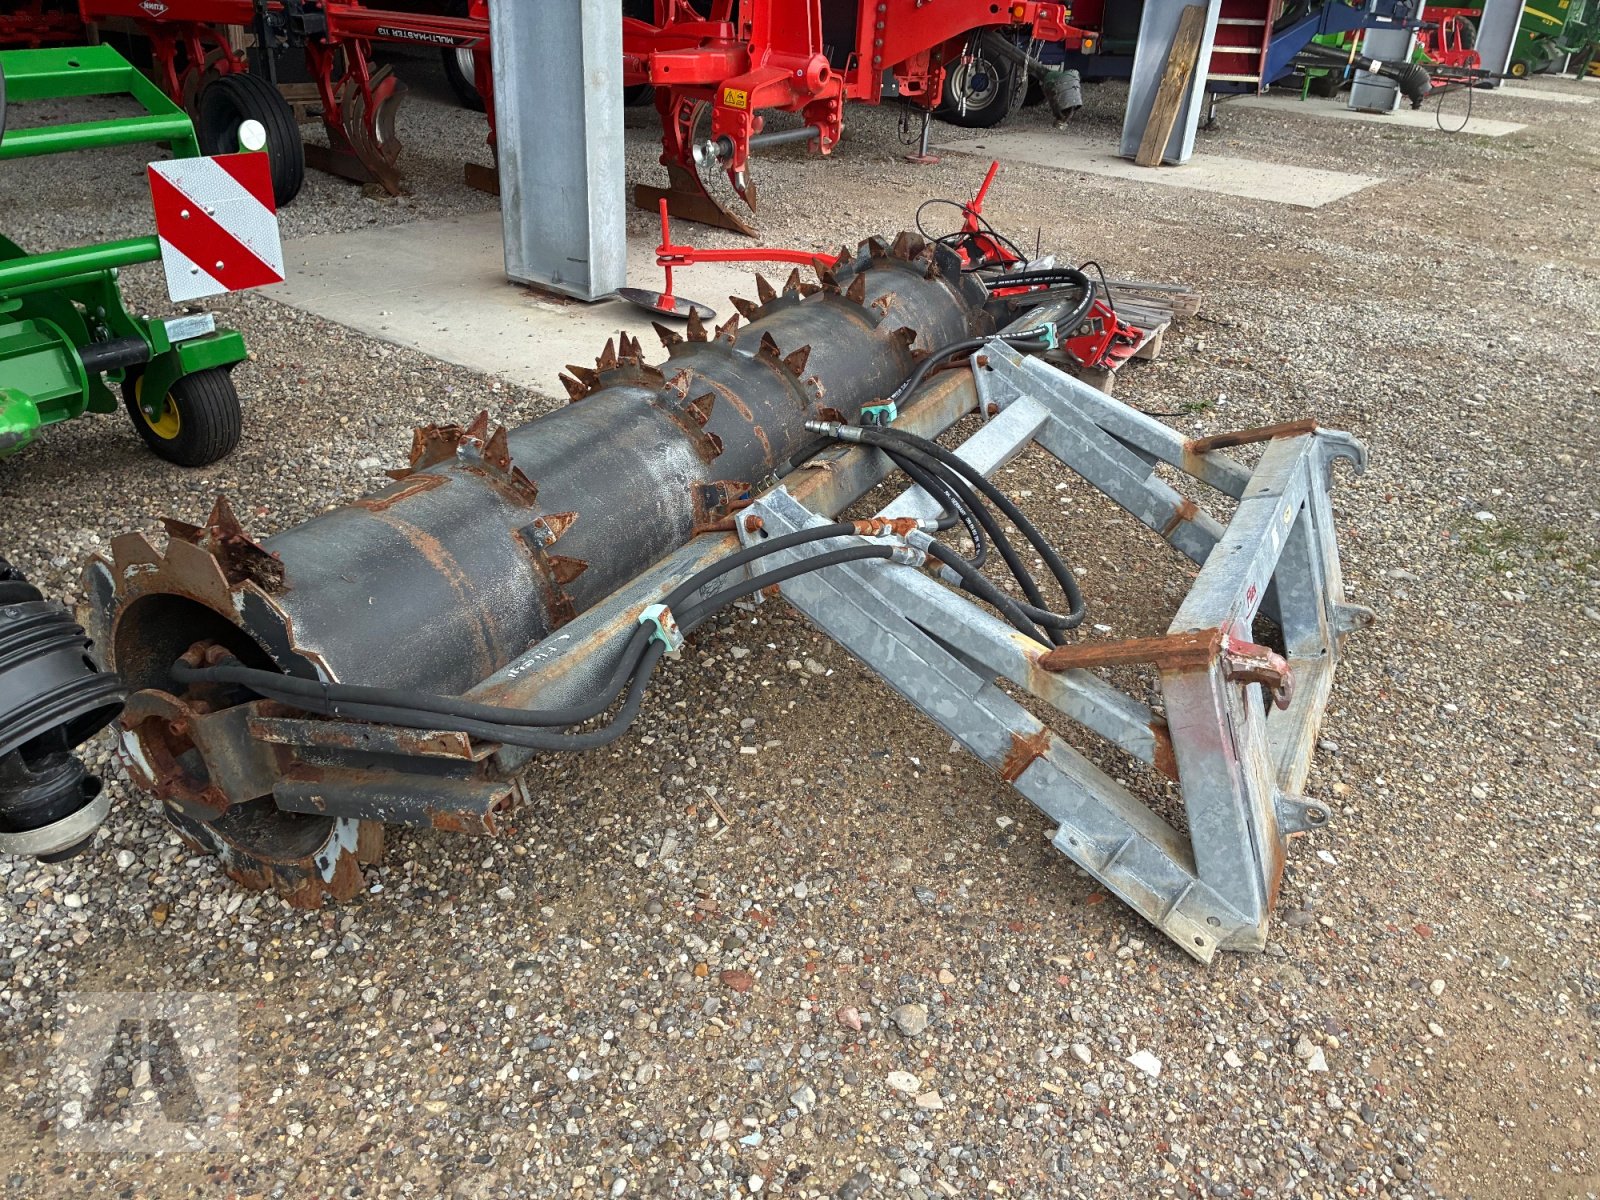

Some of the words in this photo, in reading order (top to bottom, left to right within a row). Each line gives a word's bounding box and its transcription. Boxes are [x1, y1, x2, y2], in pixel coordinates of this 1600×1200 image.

[143, 2, 164, 11] KUHN
[377, 27, 389, 36] 113
[391, 29, 454, 45] MULTI-MASTER
